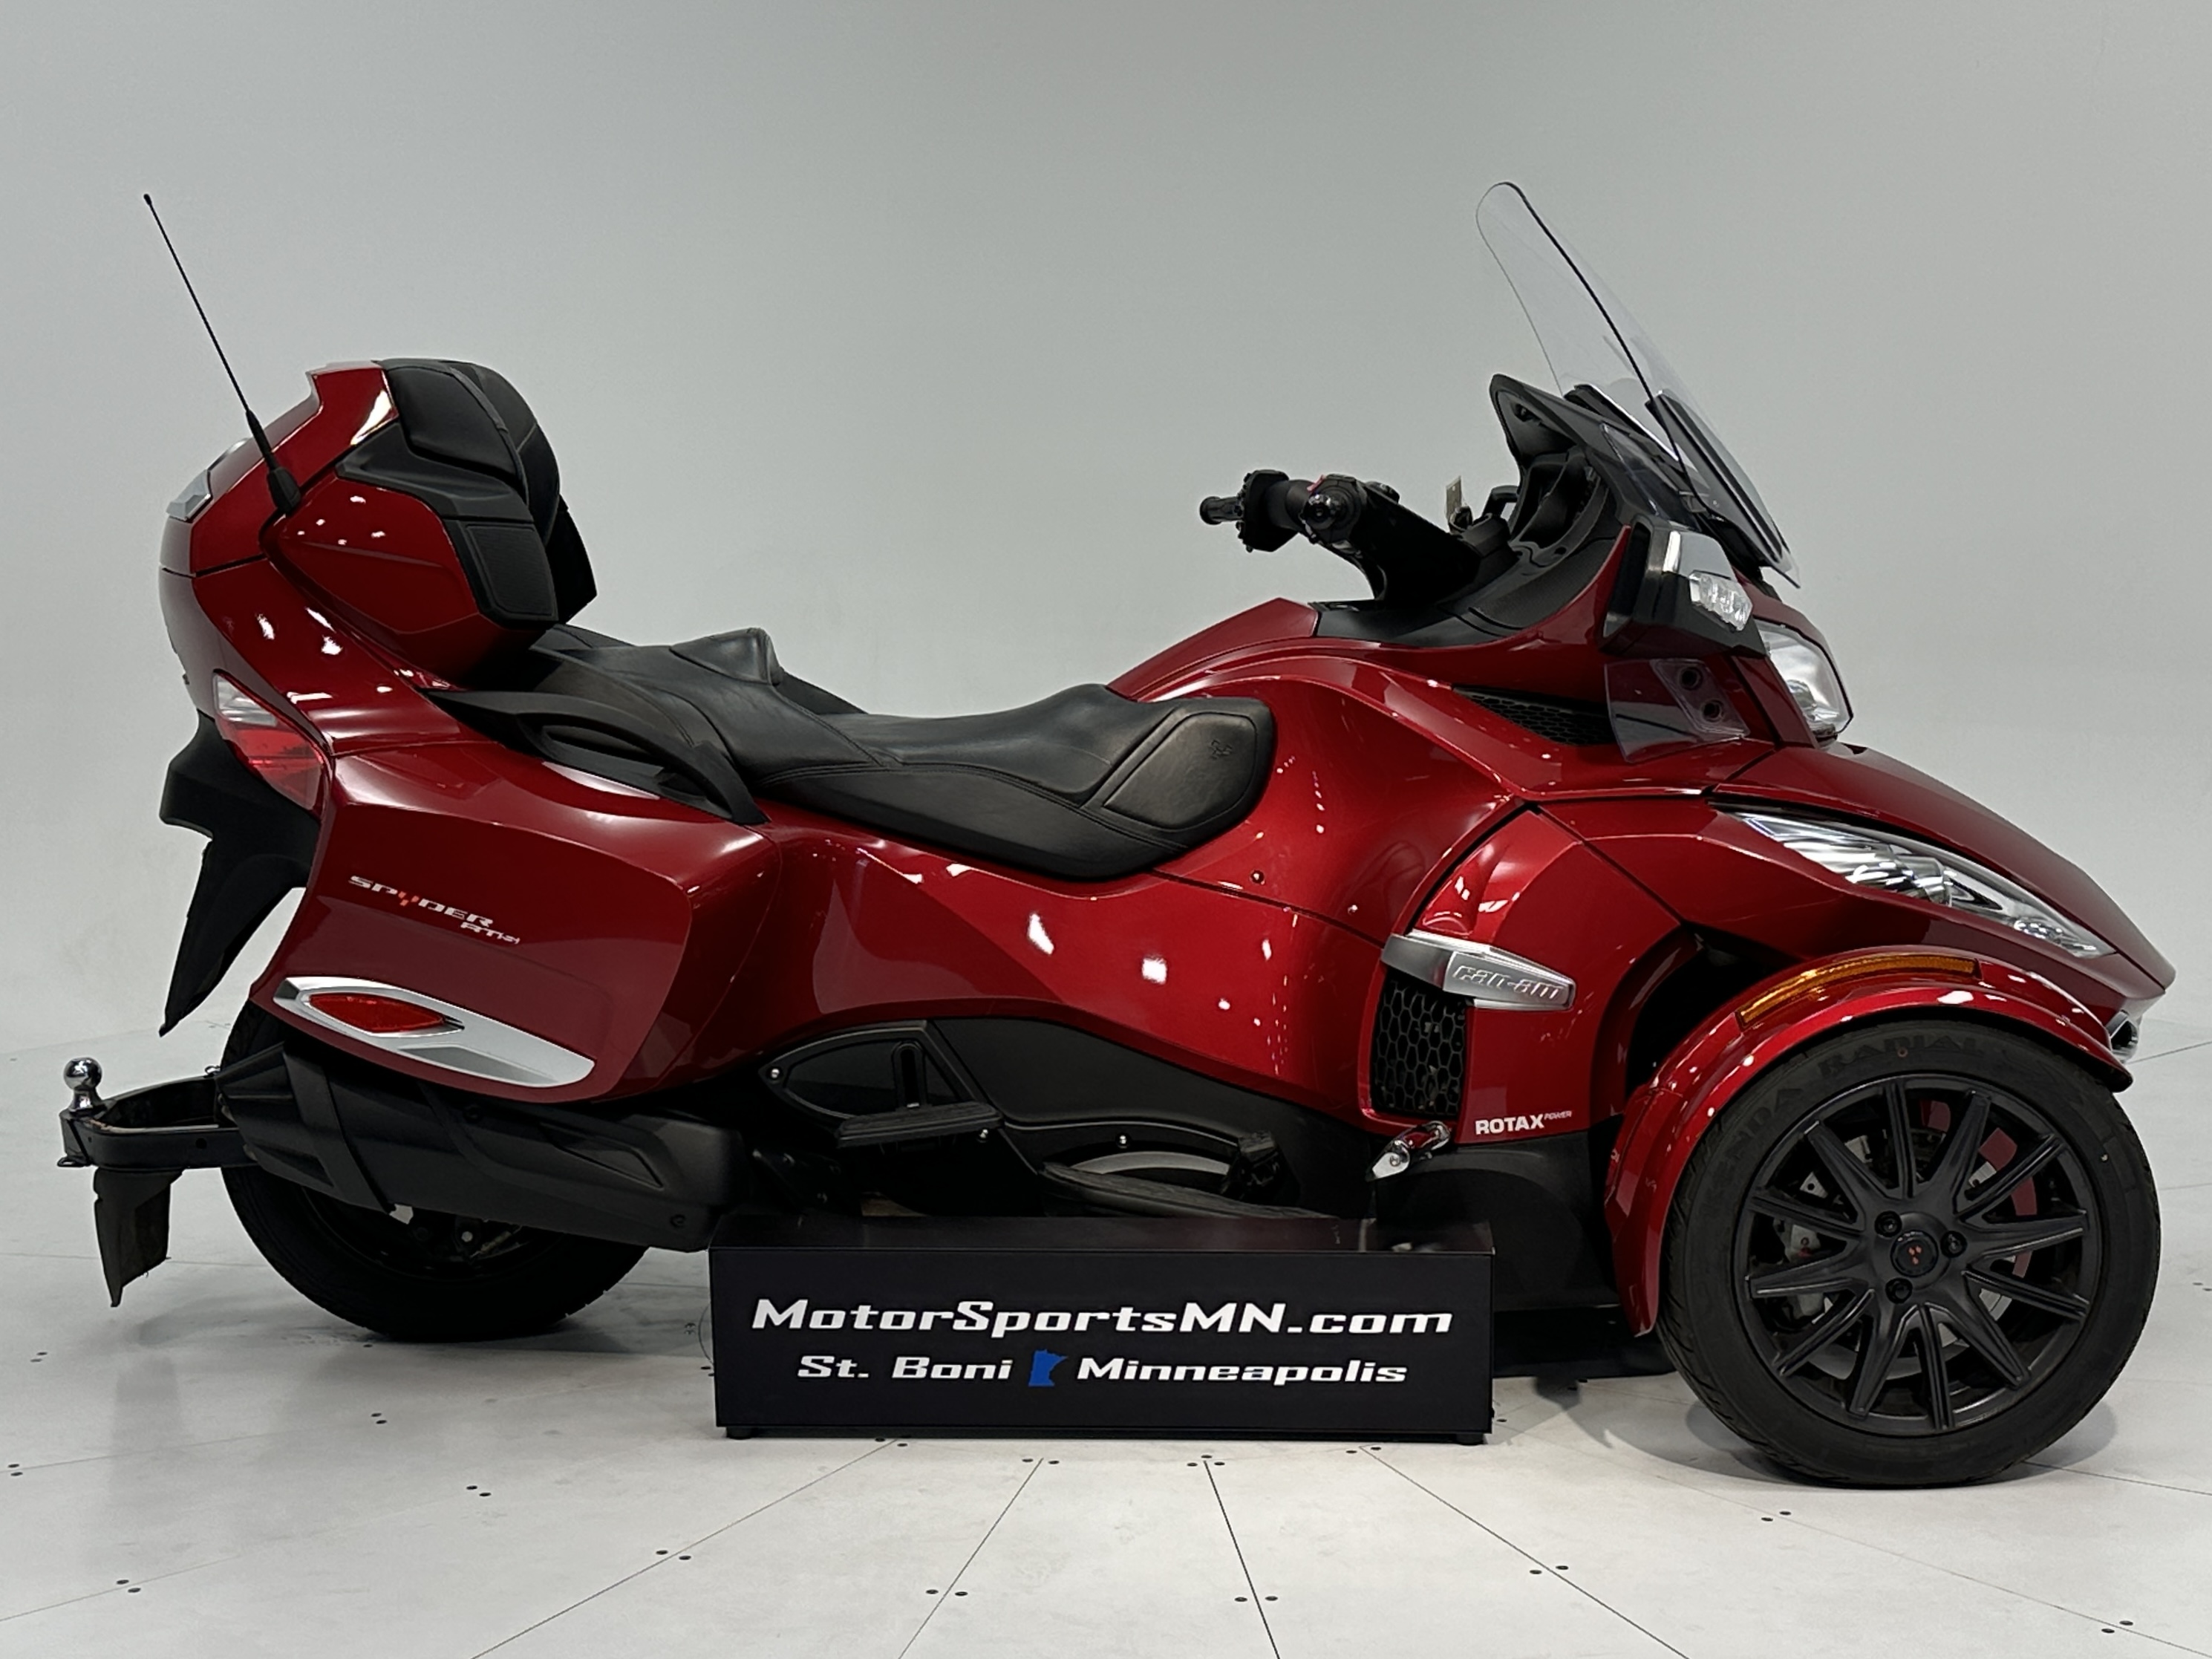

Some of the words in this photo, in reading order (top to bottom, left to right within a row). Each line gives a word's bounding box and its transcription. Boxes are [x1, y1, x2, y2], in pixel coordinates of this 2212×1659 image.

[348, 876, 494, 928] SPYDER
[1475, 1113, 1545, 1135] ROTAX
[751, 1299, 1453, 1339] MotorSportsMN.com
[797, 1355, 870, 1379] St.
[891, 1356, 1014, 1381] Boni
[1076, 1357, 1408, 1386] Minneapolis
